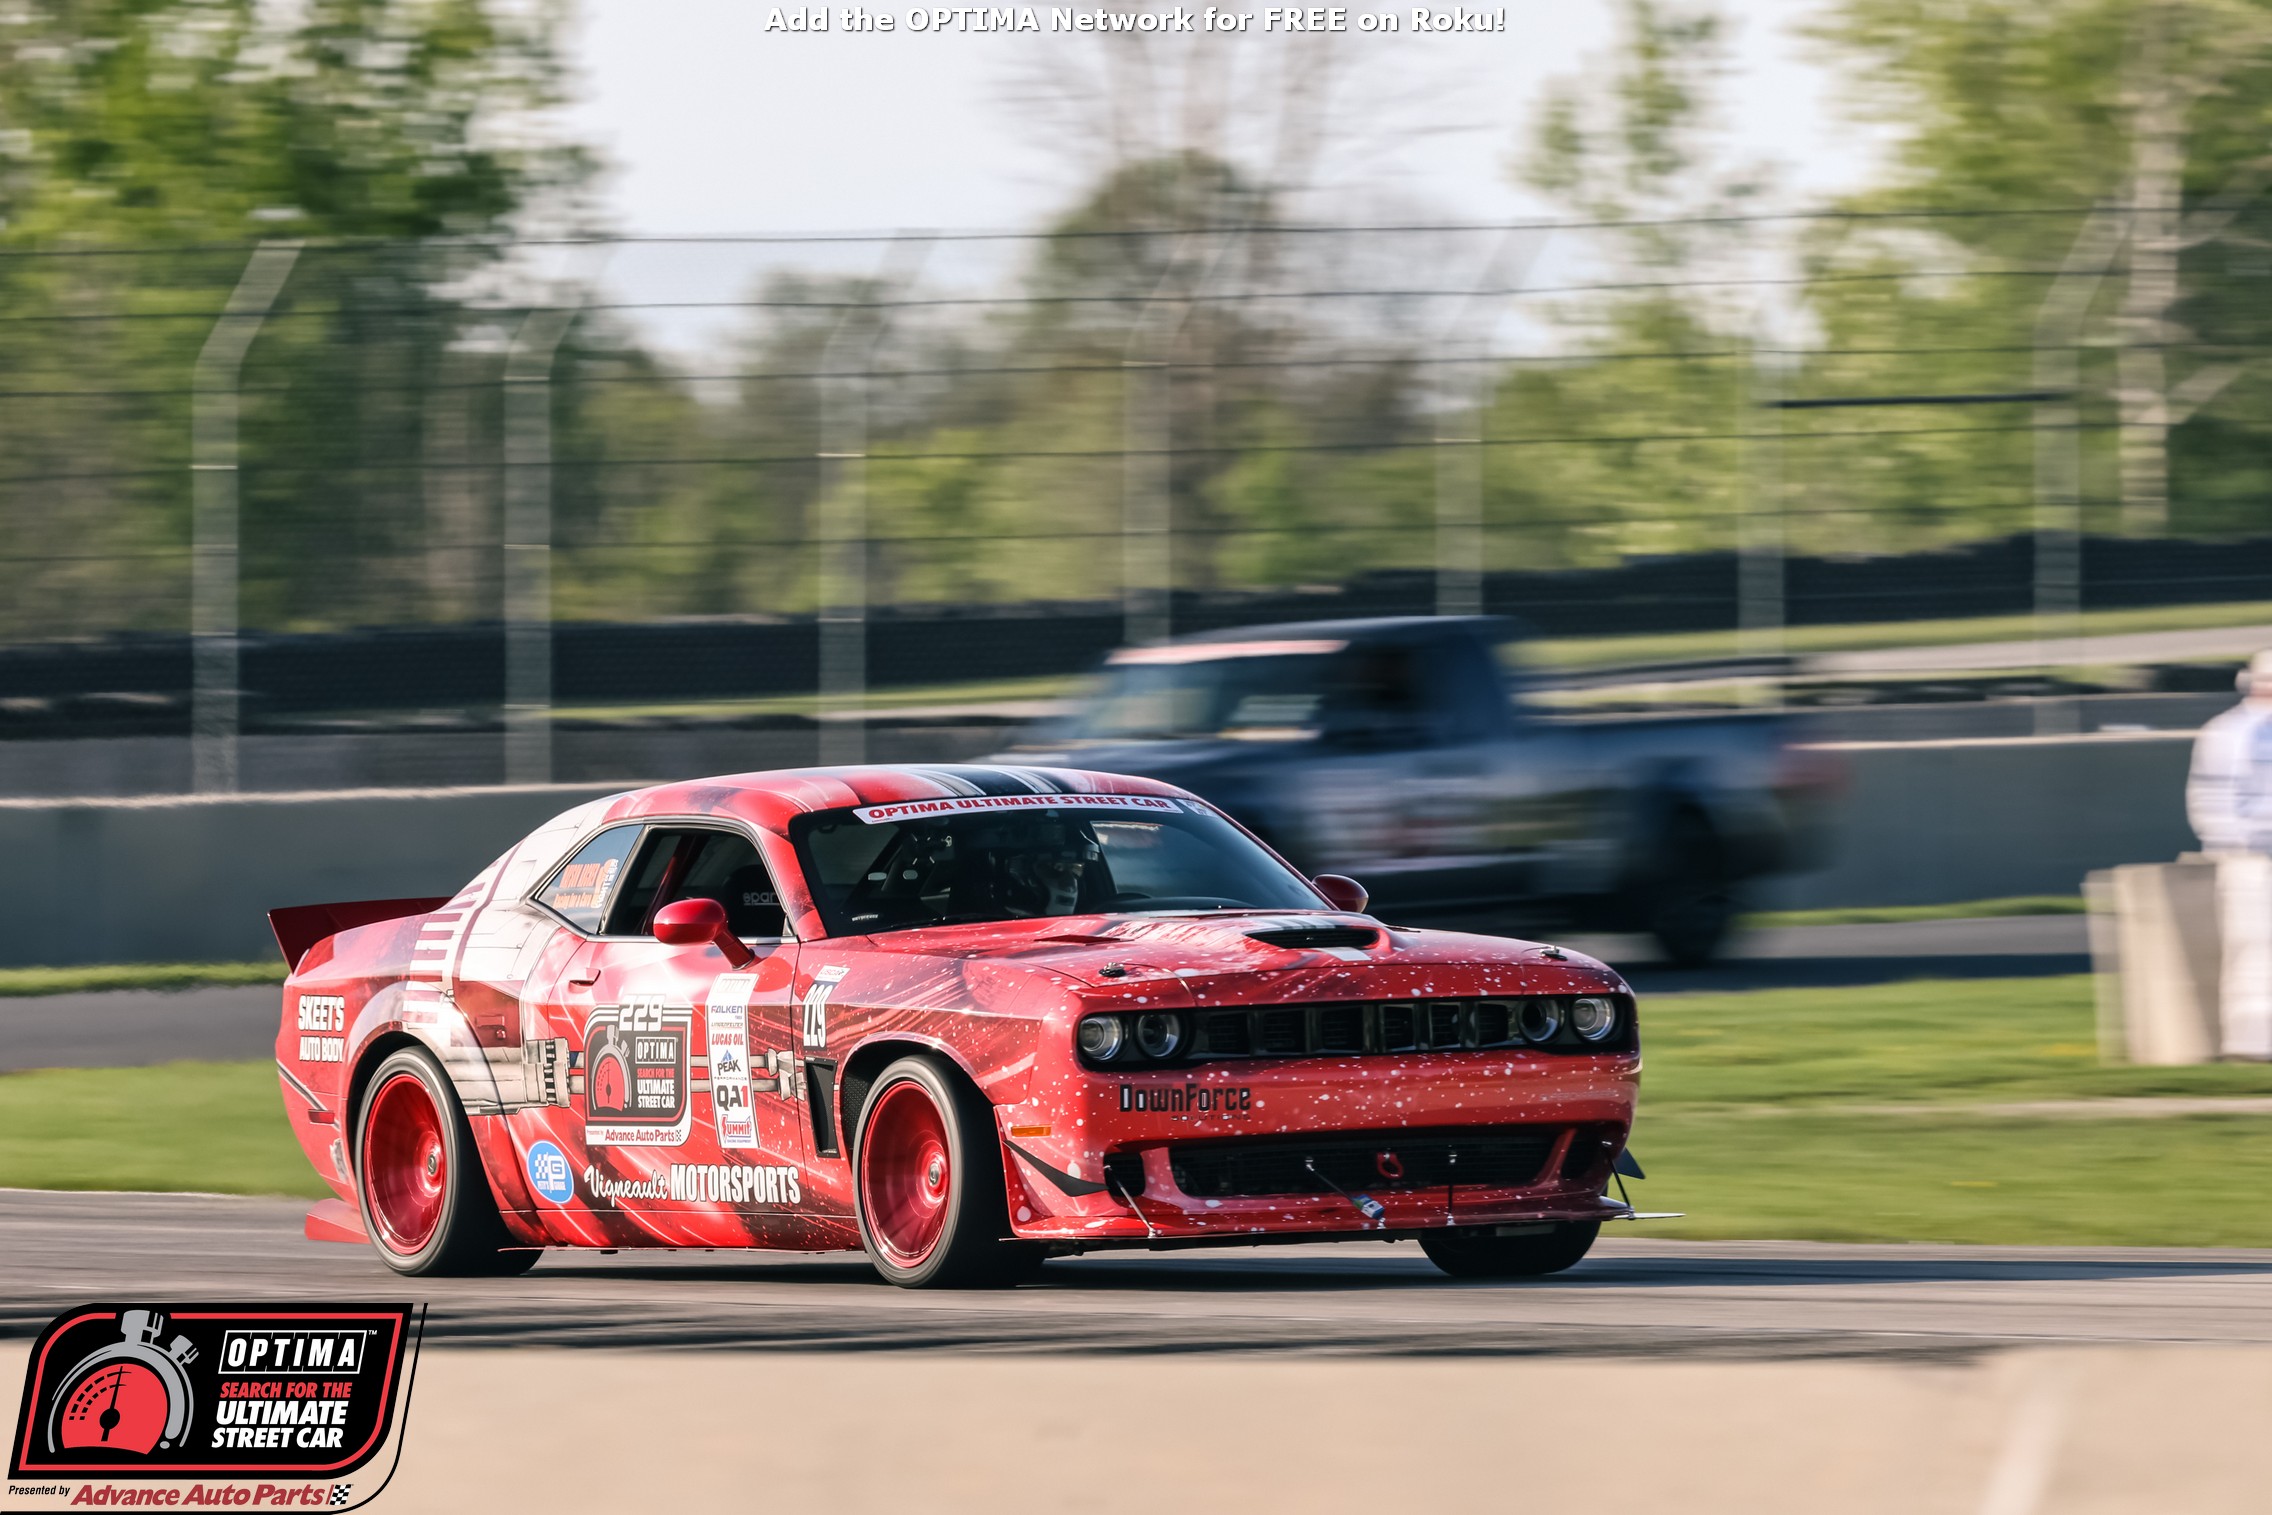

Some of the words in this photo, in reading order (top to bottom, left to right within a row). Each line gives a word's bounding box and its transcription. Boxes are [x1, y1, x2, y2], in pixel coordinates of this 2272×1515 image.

[868, 801, 954, 818] OPTIMA
[956, 796, 1056, 809] ULTIMATE
[1060, 796, 1128, 806] STREET
[1131, 798, 1171, 808] CAR
[619, 994, 665, 1032] 229
[711, 1006, 743, 1014] FALKEN
[803, 984, 834, 1048] 229
[711, 1033, 732, 1046] LUCAS
[733, 1033, 744, 1046] OIL
[299, 1036, 321, 1062] AUTO
[321, 1037, 345, 1063] BODY
[637, 1042, 674, 1060] OPTIMA
[637, 1068, 655, 1078] SEARCH
[656, 1068, 665, 1078] FOR
[666, 1068, 675, 1078] THE
[717, 1060, 741, 1075] PEAK
[637, 1079, 675, 1095] ULTIMATE
[638, 1096, 661, 1109] STREET
[661, 1096, 676, 1109] CAR
[717, 1085, 749, 1111] QA1
[1119, 1083, 1251, 1112] DownForce
[605, 1129, 635, 1142] Advance
[636, 1129, 655, 1142] Auto
[655, 1129, 675, 1142] Parts
[584, 1164, 668, 1207] Vigneault
[670, 1163, 800, 1204] MOTORSPORTS
